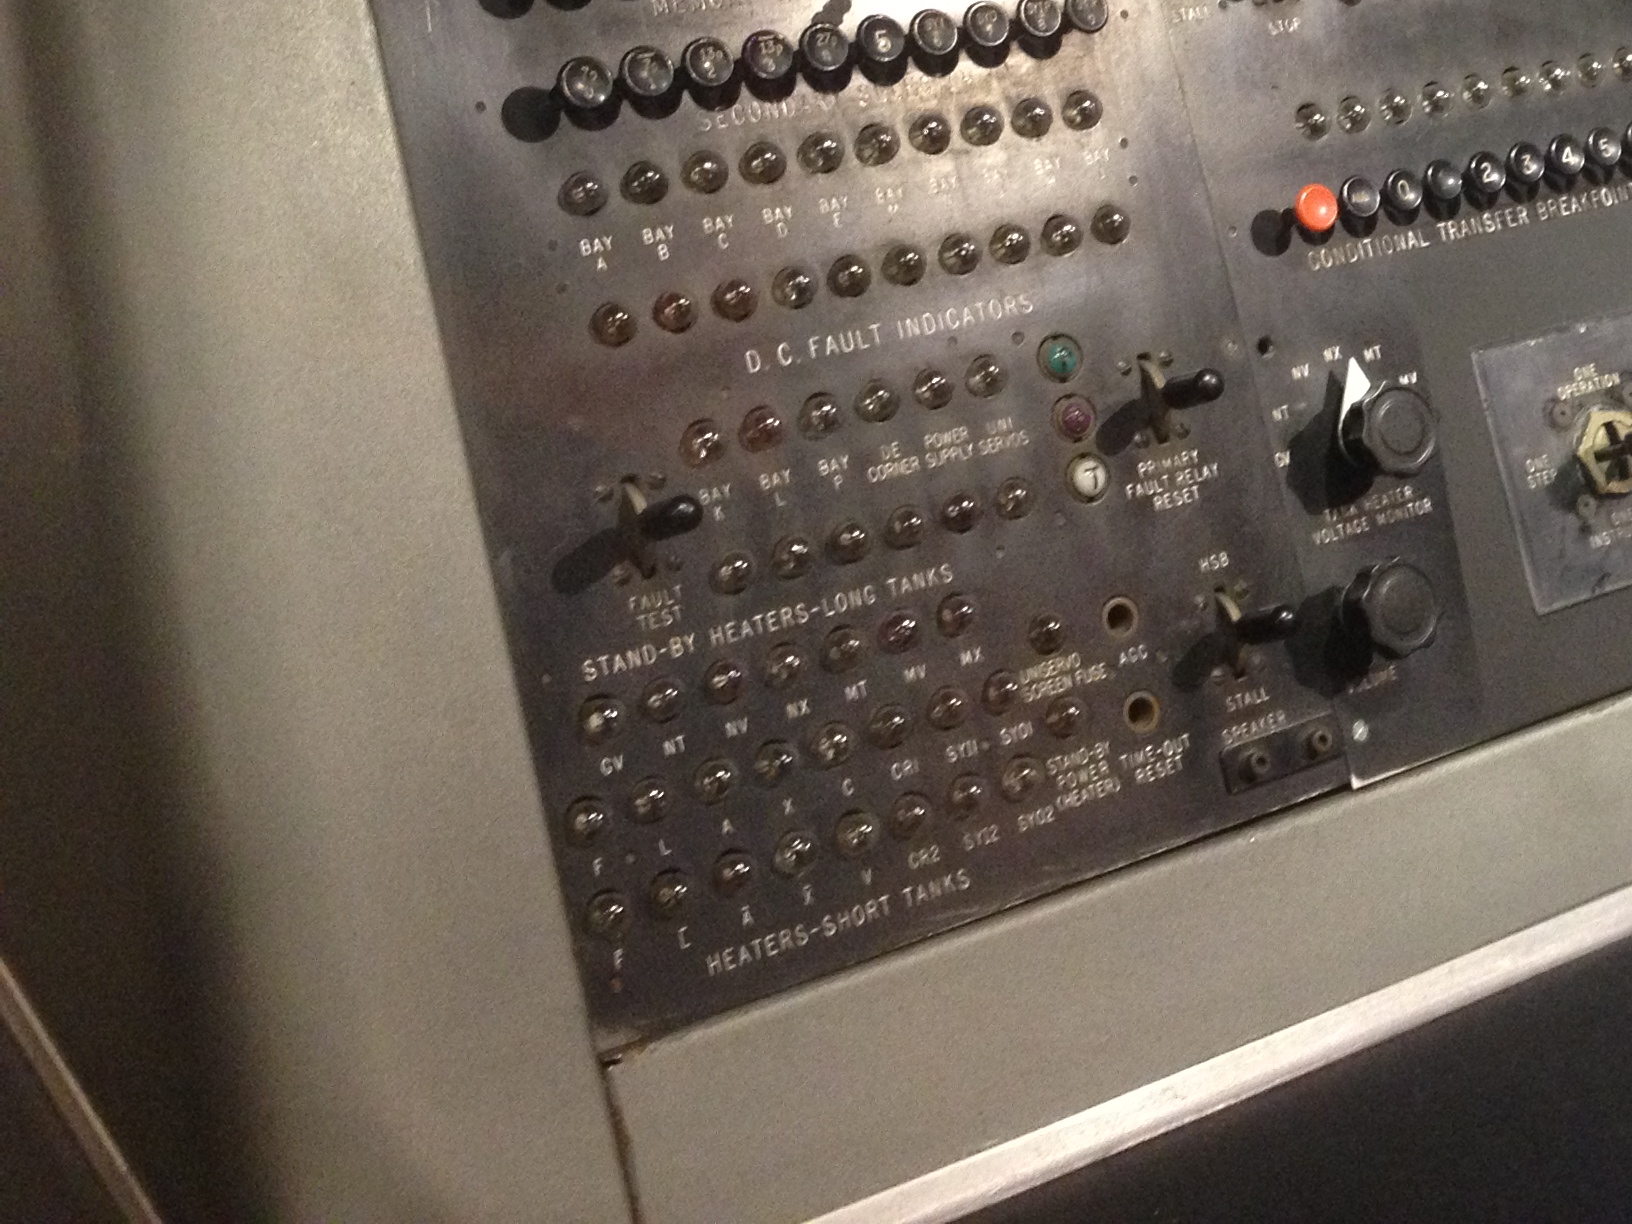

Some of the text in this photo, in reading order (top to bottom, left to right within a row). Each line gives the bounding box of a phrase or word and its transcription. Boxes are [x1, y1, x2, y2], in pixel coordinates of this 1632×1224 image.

[874, 29, 892, 53] 5
[1480, 160, 1494, 182] 2
[1521, 153, 1535, 175] 3
[1561, 145, 1575, 166] 4
[1599, 138, 1613, 158] 5
[761, 206, 793, 224] BAY
[818, 196, 848, 214] BAY
[642, 225, 675, 245] BAY
[702, 215, 734, 234] BAY
[1306, 228, 1430, 271] CONDITIONAL
[1436, 201, 1530, 244] TRANSFER
[579, 235, 613, 257] BAY
[657, 244, 670, 261] B
[718, 233, 730, 250] C
[596, 257, 608, 272] A
[808, 293, 1034, 361] FAULT INDICATORS
[1556, 372, 1621, 402] OPERATION
[924, 425, 969, 450] POWER
[817, 454, 849, 476] BAY
[924, 442, 974, 469] SUPPLY
[1137, 448, 1199, 478] PRIMARY
[758, 468, 791, 492] BAY
[833, 475, 844, 492] P
[1125, 462, 1220, 501] FAULT RELAY
[699, 483, 732, 506] BAY
[774, 492, 787, 507] L
[1152, 484, 1201, 512] RESET
[713, 505, 726, 522] K
[1312, 516, 1370, 546] VOLTAGE
[628, 584, 684, 612] FAULT
[581, 562, 954, 683] STAND-BY HEATERS-LONG TANKS
[635, 605, 683, 632] TEST
[1224, 686, 1271, 714] STALL
[662, 734, 686, 757] NT
[1118, 731, 1191, 770] TIME-OUT
[1133, 754, 1184, 785] RESET
[841, 778, 855, 796] C
[721, 818, 736, 837] A
[658, 838, 673, 857] L
[592, 857, 604, 877] F
[705, 867, 971, 977] HEATERS-SHORT TANKS
